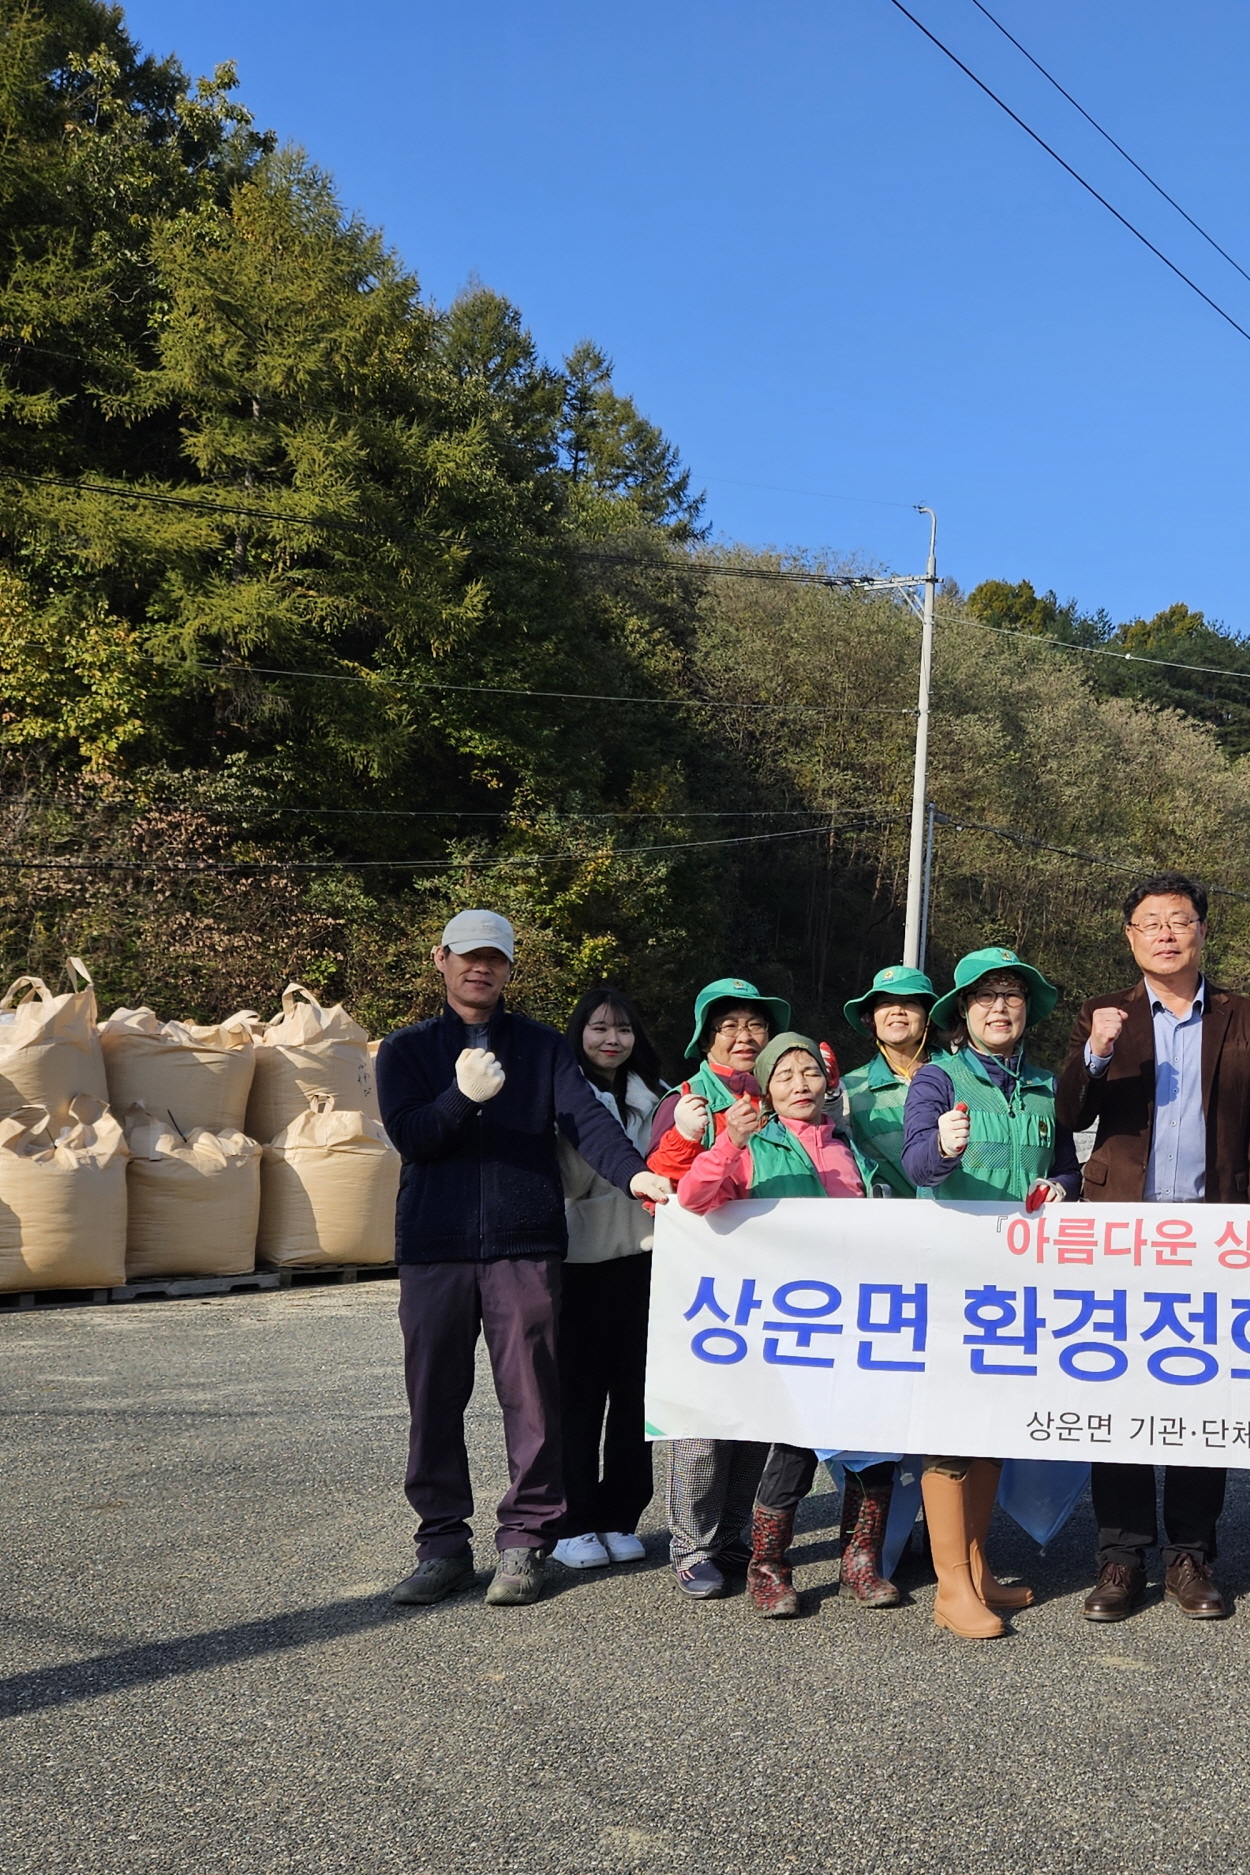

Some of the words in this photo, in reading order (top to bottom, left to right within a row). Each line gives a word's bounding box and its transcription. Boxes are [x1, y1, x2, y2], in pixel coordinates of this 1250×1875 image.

[996, 1216, 1197, 1267] 『아름다운
[683, 1276, 928, 1372] 상운면
[1026, 1411, 1112, 1443] 상운면
